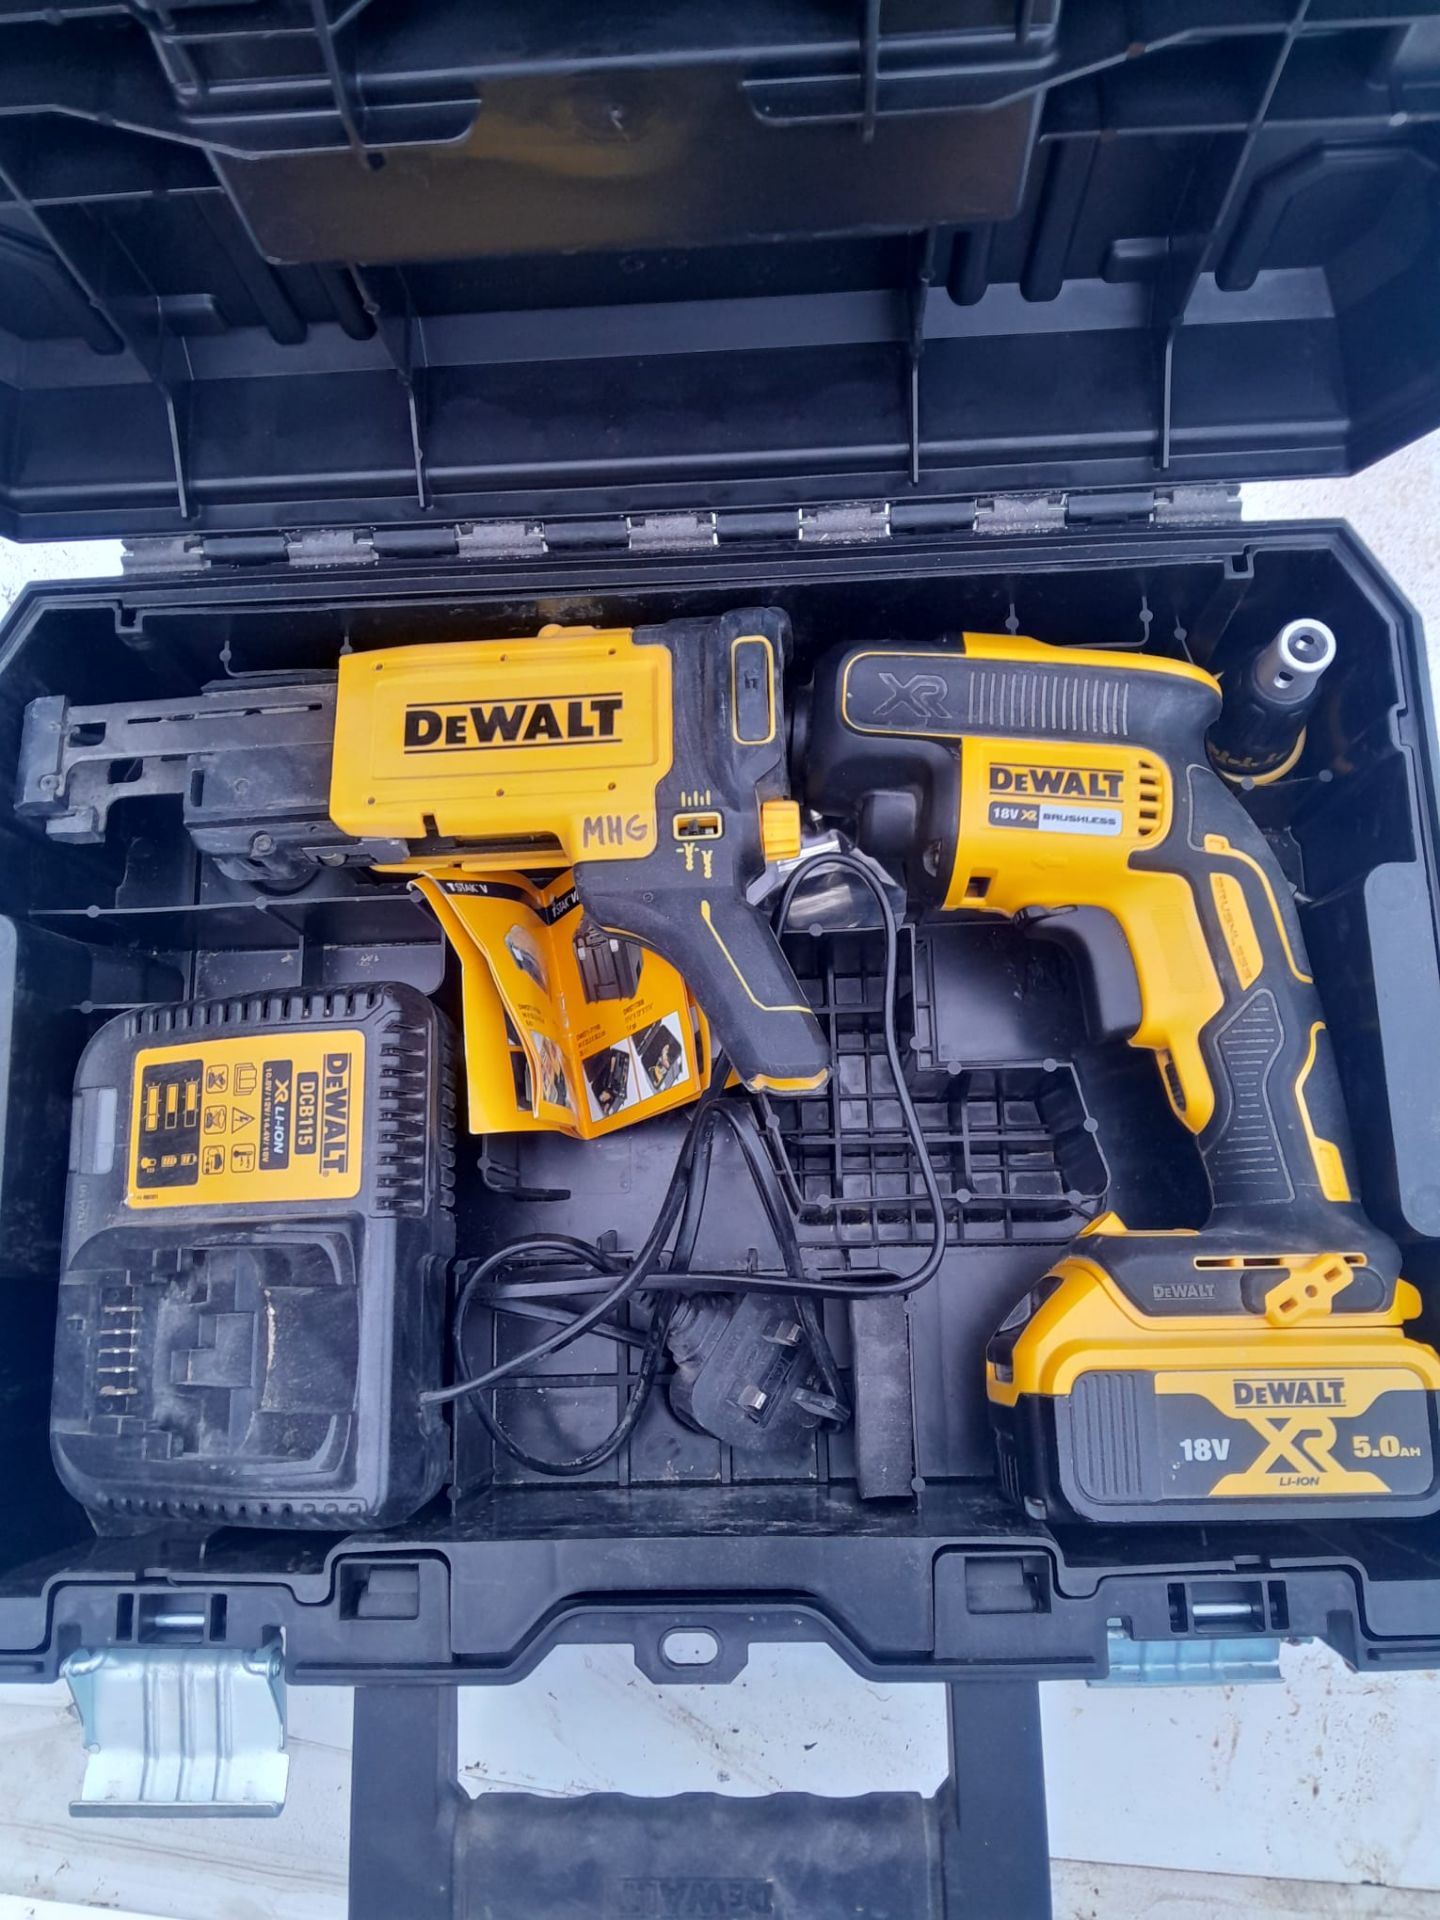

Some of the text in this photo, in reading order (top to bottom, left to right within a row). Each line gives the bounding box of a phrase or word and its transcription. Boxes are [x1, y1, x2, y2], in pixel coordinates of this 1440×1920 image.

[873, 672, 953, 719] XR
[583, 814, 649, 849] MHG
[993, 806, 1019, 821] 18V
[1042, 812, 1117, 826] BRUSHLESS
[272, 1079, 290, 1155] XR LI-ION
[297, 1081, 316, 1146] DCB115
[1179, 1438, 1230, 1462] 18V
[1246, 1416, 1348, 1474] XR
[1279, 1476, 1320, 1487] LI-ION
